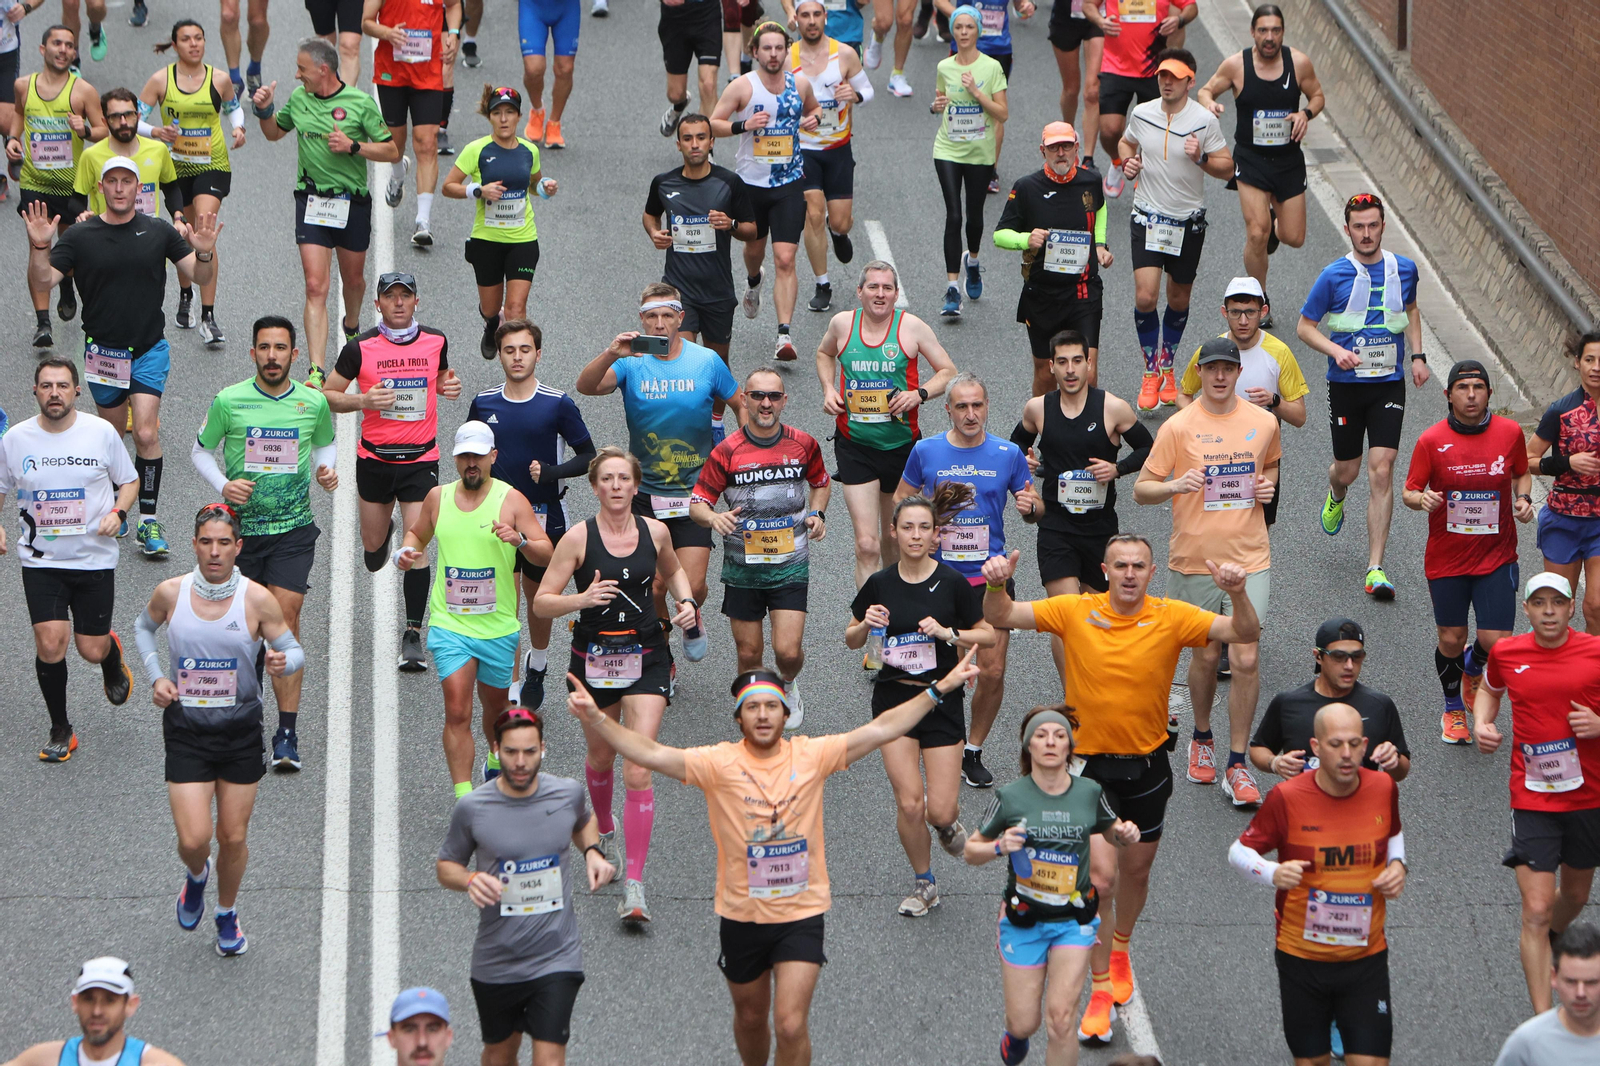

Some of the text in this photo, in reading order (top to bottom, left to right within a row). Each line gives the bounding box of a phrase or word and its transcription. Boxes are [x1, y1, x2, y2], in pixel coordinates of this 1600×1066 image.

[1062, 235, 1086, 243] ZURICH
[1059, 247, 1076, 255] 8353
[101, 349, 126, 358] ZURICH
[99, 360, 116, 369] 6934
[377, 358, 429, 369] PUCELA TROTA
[851, 360, 896, 373] MAYO AC
[98, 369, 118, 380] BRANKO
[641, 377, 695, 393] MÁRTON
[1203, 452, 1229, 460] Maratón
[42, 456, 99, 468] RepScan
[1222, 465, 1250, 473] ZURICH
[735, 467, 803, 485] HUNGARY
[1221, 480, 1239, 488] 6463
[1074, 486, 1092, 494] 8206
[50, 491, 80, 499] ZURICH
[50, 507, 69, 515] 7507
[1464, 506, 1482, 514] 7952
[55, 517, 83, 525] REPSCAN
[760, 520, 788, 528] ZURICH
[957, 516, 984, 524] ZURICH
[956, 532, 973, 540] 7949
[461, 570, 489, 578] ZURICH
[623, 568, 629, 579] S
[619, 612, 626, 622] R
[900, 635, 929, 643] ZURICH
[900, 651, 918, 659] 7778
[199, 661, 232, 669] ZURICH
[604, 660, 623, 668] 6418
[198, 676, 218, 684] 7869
[1537, 742, 1569, 754] ZURICH
[1539, 760, 1560, 770] 6903
[1027, 825, 1083, 840] FINISHER
[769, 845, 801, 856] ZURICH
[1039, 852, 1072, 863] ZURICH
[520, 859, 553, 871] ZURICH
[769, 863, 791, 873] 7613
[1036, 868, 1056, 880] 4512
[520, 879, 542, 889] 9434
[767, 877, 793, 886] TORRES
[1330, 895, 1365, 905] ZURICH
[1328, 912, 1349, 921] 7421
[1332, 926, 1362, 934] MORENO
